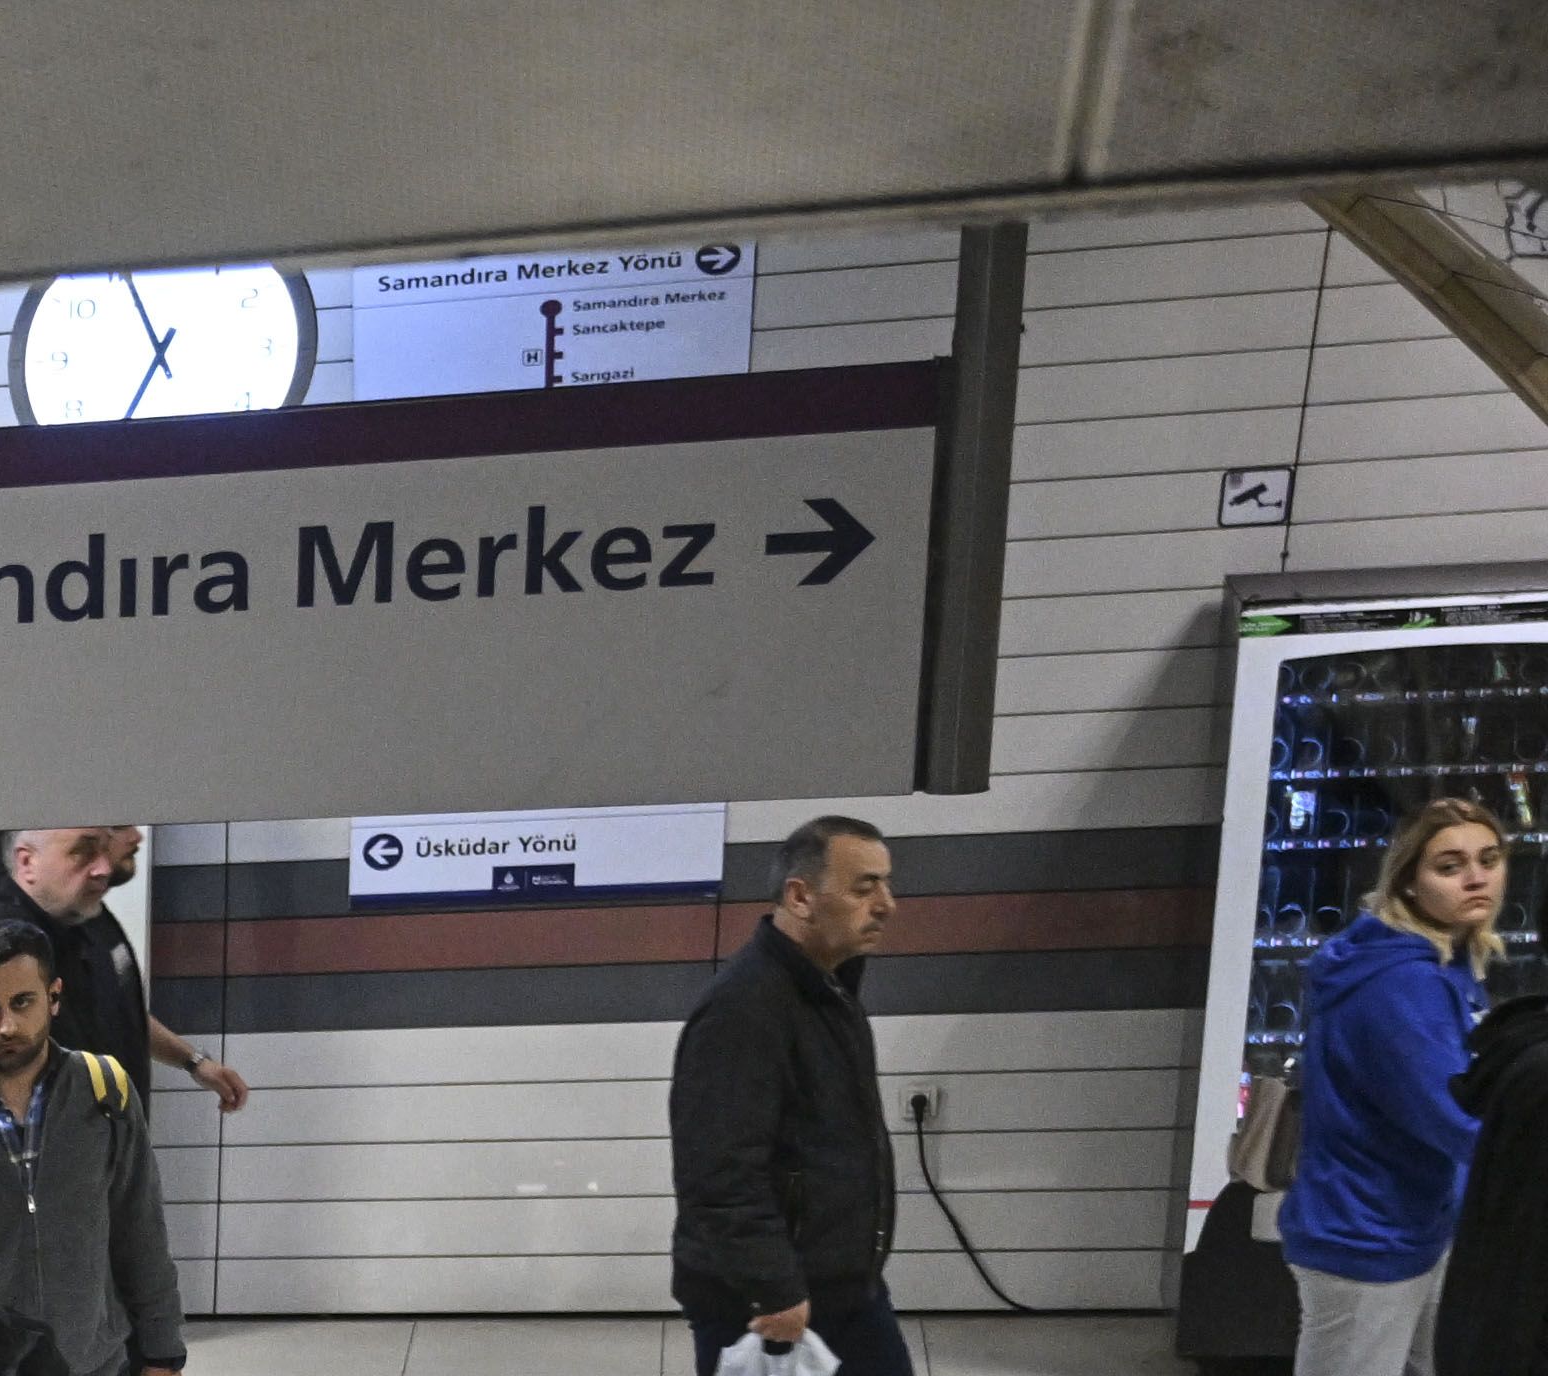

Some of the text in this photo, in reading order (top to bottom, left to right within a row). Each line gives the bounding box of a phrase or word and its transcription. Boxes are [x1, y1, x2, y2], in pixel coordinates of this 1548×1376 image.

[378, 250, 682, 293] Samandıra Merkez Yönü
[572, 289, 726, 312] Samandıra Merkez
[572, 318, 665, 337] Sancaktepe
[571, 367, 635, 385] Sarıgazi
[296, 503, 718, 609] Merkez
[416, 833, 577, 858] Üsküdar Yönü
